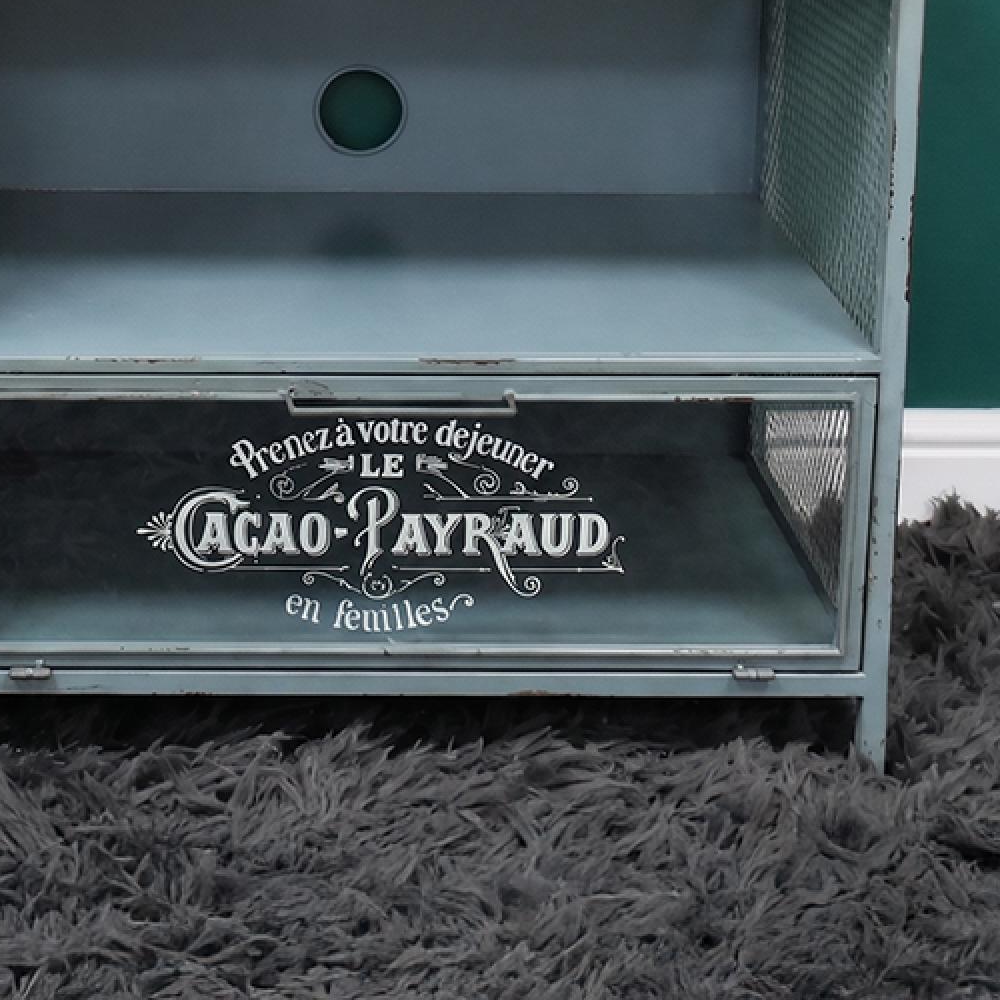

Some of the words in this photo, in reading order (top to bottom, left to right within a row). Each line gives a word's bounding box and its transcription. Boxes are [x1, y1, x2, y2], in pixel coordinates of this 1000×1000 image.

[229, 425, 331, 479] Prenez
[336, 418, 356, 447] à
[357, 418, 429, 446] votre
[435, 419, 555, 480] dejeuner
[359, 453, 405, 479] LE
[285, 594, 321, 624] en
